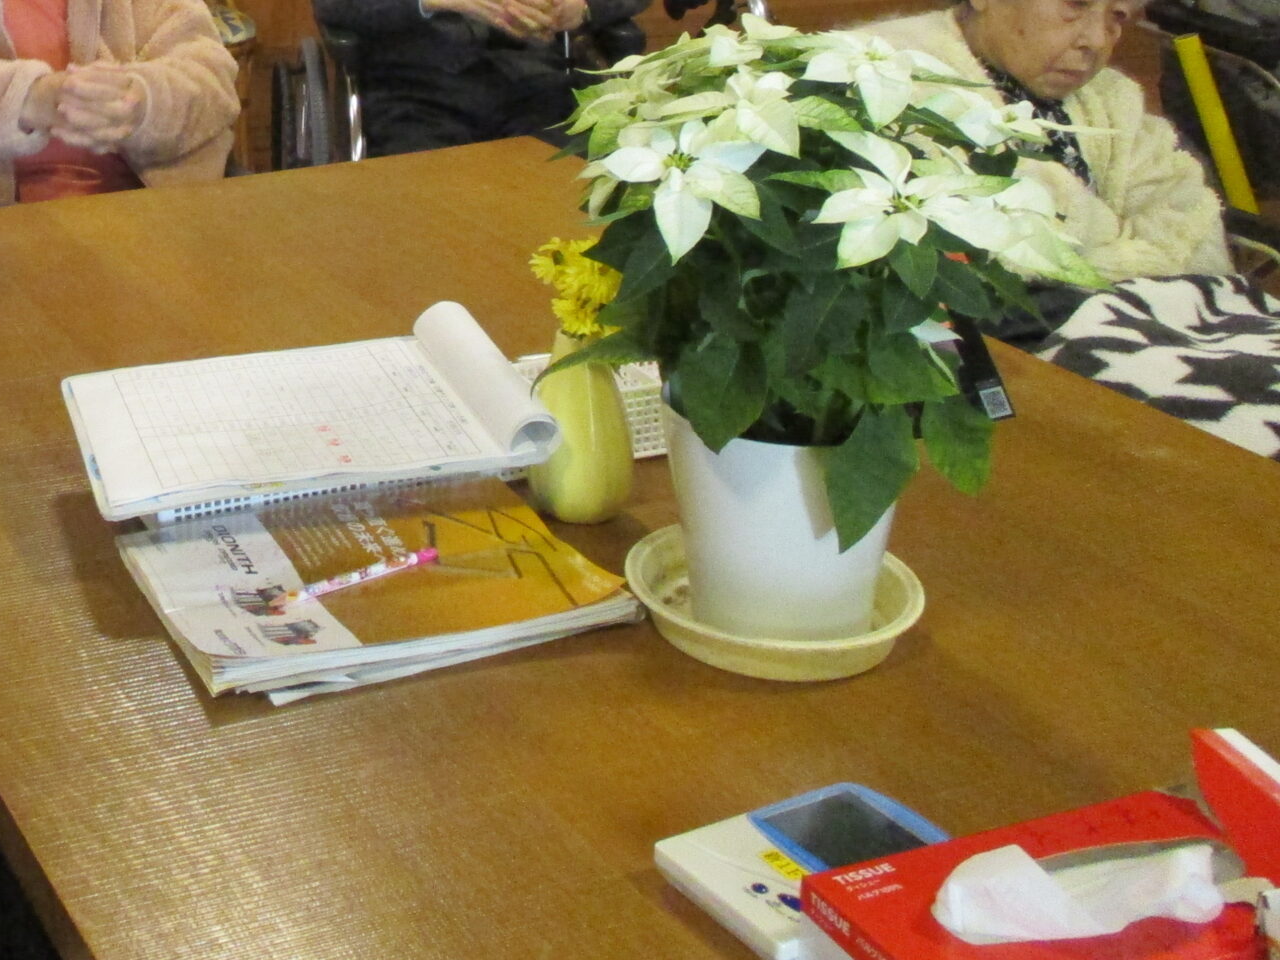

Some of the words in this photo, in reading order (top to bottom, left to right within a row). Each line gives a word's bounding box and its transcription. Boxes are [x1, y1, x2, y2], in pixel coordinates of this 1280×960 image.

[212, 524, 259, 575] DIONITH
[832, 862, 896, 885] TISSUE
[811, 892, 851, 937] TISSUE
